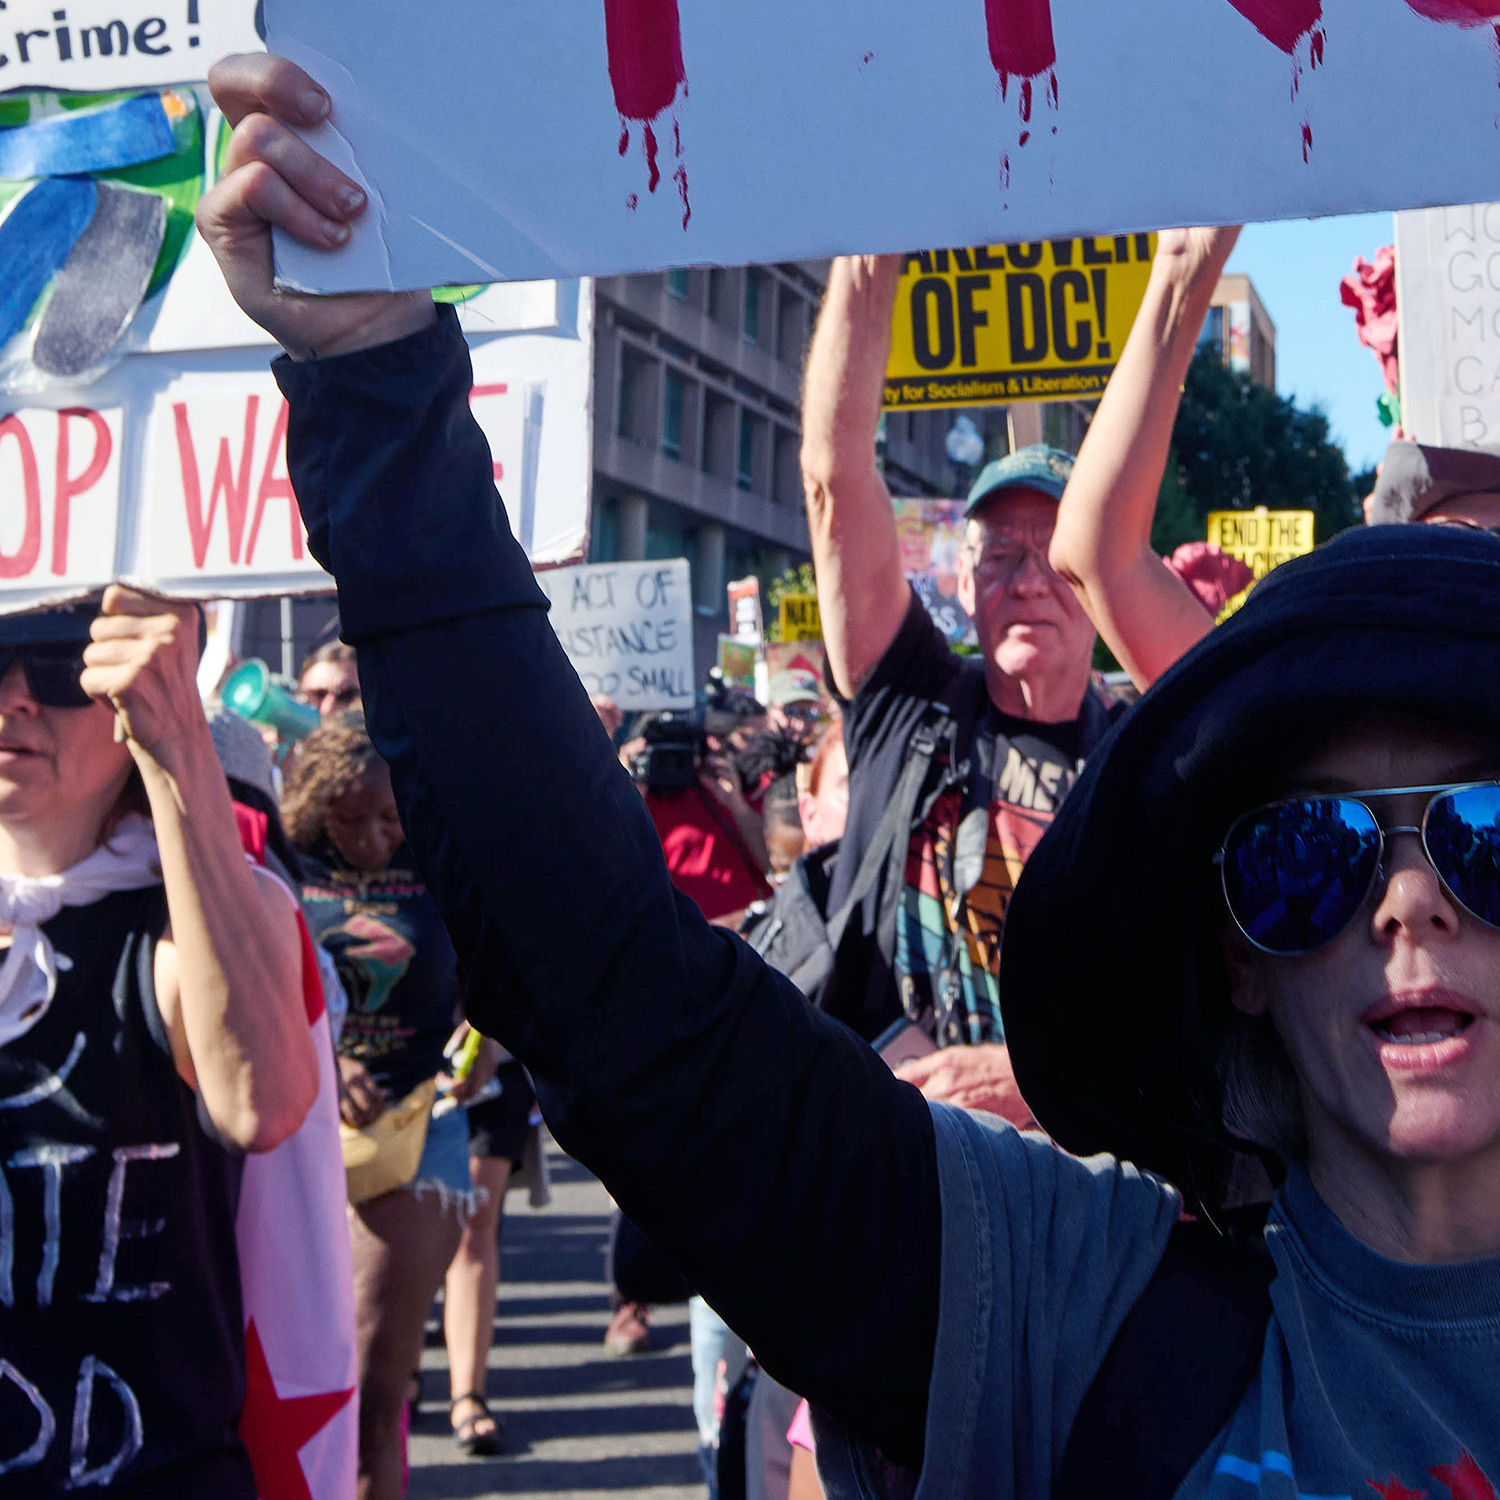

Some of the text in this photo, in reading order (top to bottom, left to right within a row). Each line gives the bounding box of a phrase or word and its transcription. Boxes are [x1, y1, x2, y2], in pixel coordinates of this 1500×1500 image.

[910, 268, 1112, 371] OF DC!
[902, 383, 925, 401] for
[927, 377, 1005, 400] Socialism
[1007, 375, 1020, 394] &
[1022, 371, 1100, 394] Liberation
[1265, 518, 1302, 546] THE
[571, 570, 674, 611] ACT OF
